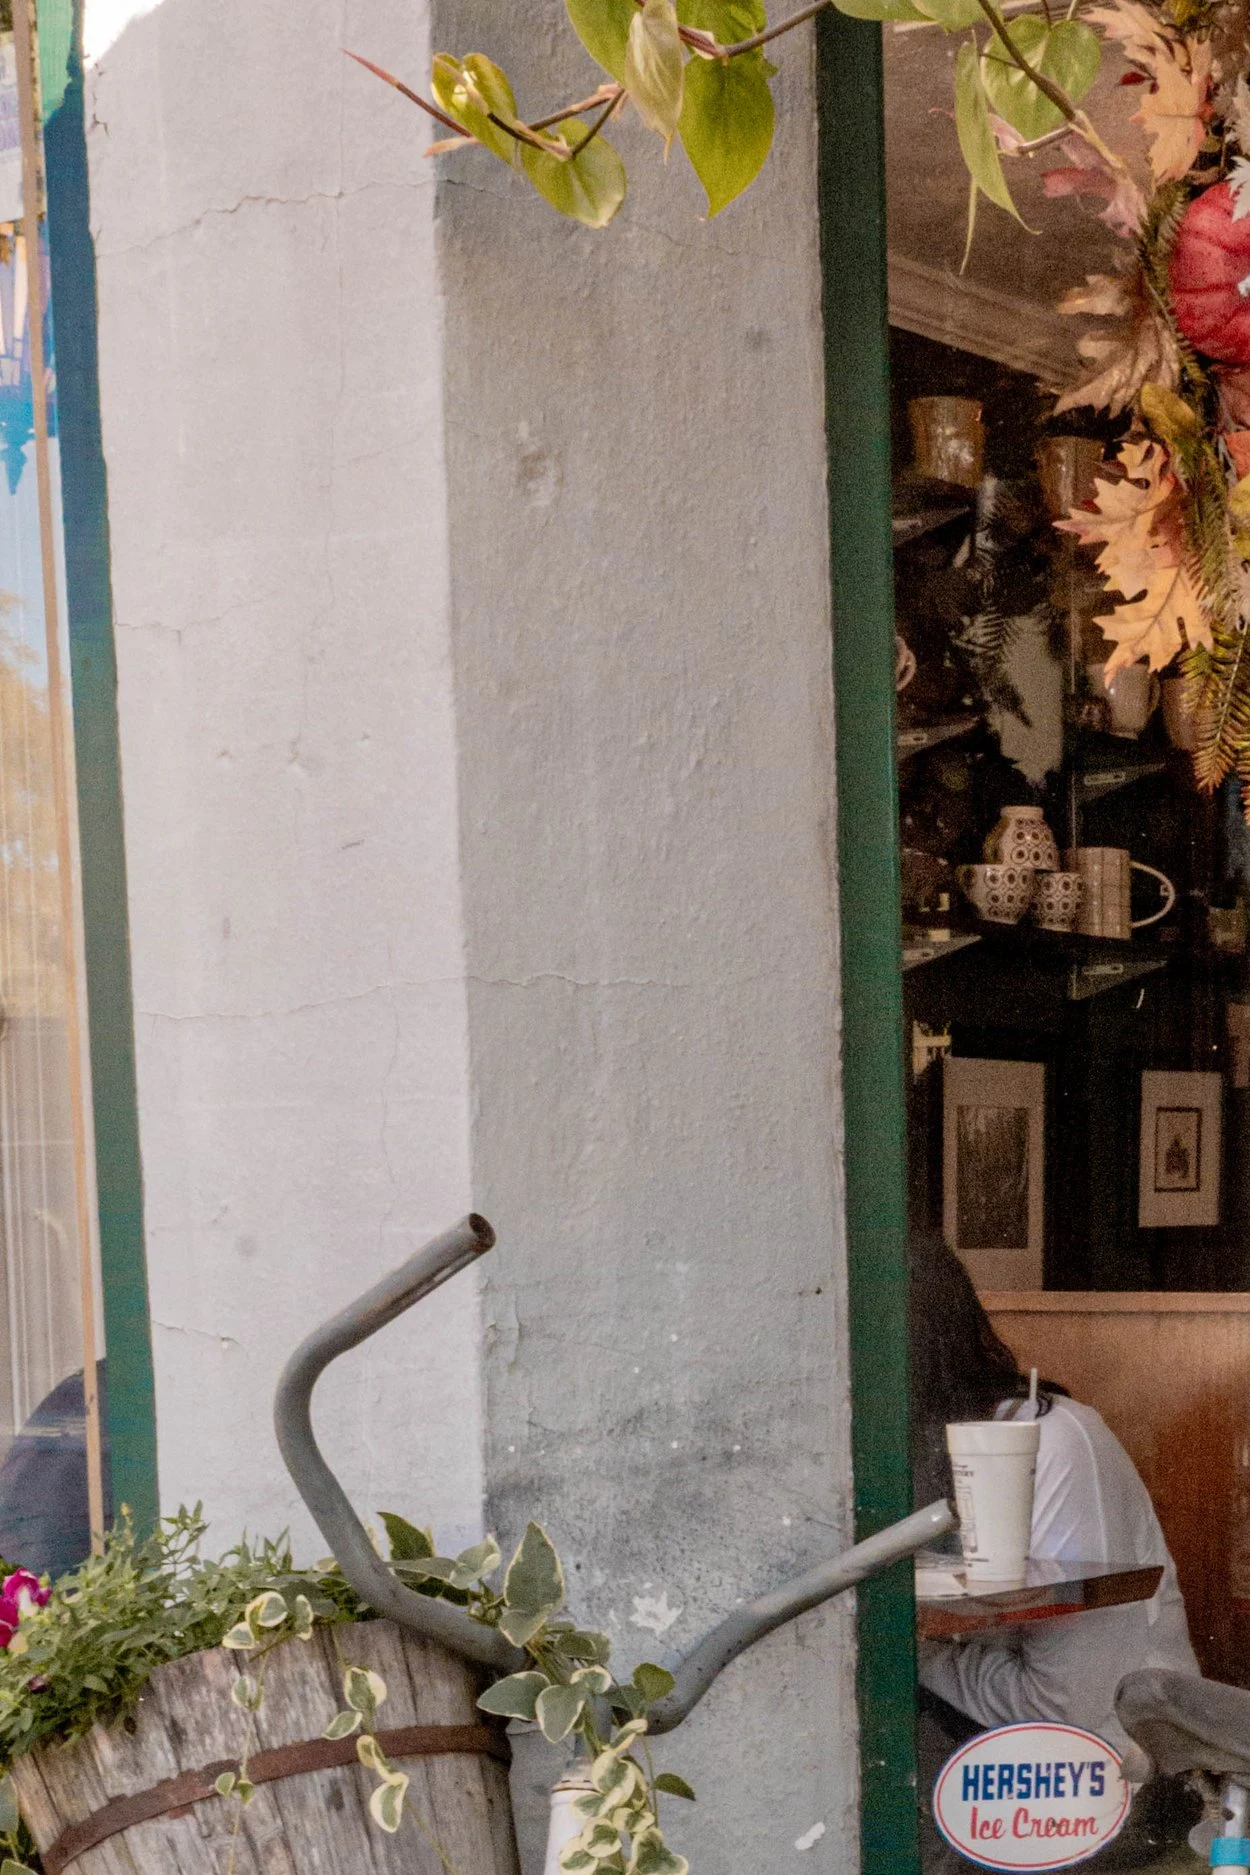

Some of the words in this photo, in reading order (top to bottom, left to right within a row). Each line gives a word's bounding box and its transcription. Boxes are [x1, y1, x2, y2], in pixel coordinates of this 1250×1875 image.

[962, 1761, 1105, 1801] HERSHEY'S
[970, 1805, 1006, 1840] Ice
[1012, 1807, 1099, 1839] Cream
